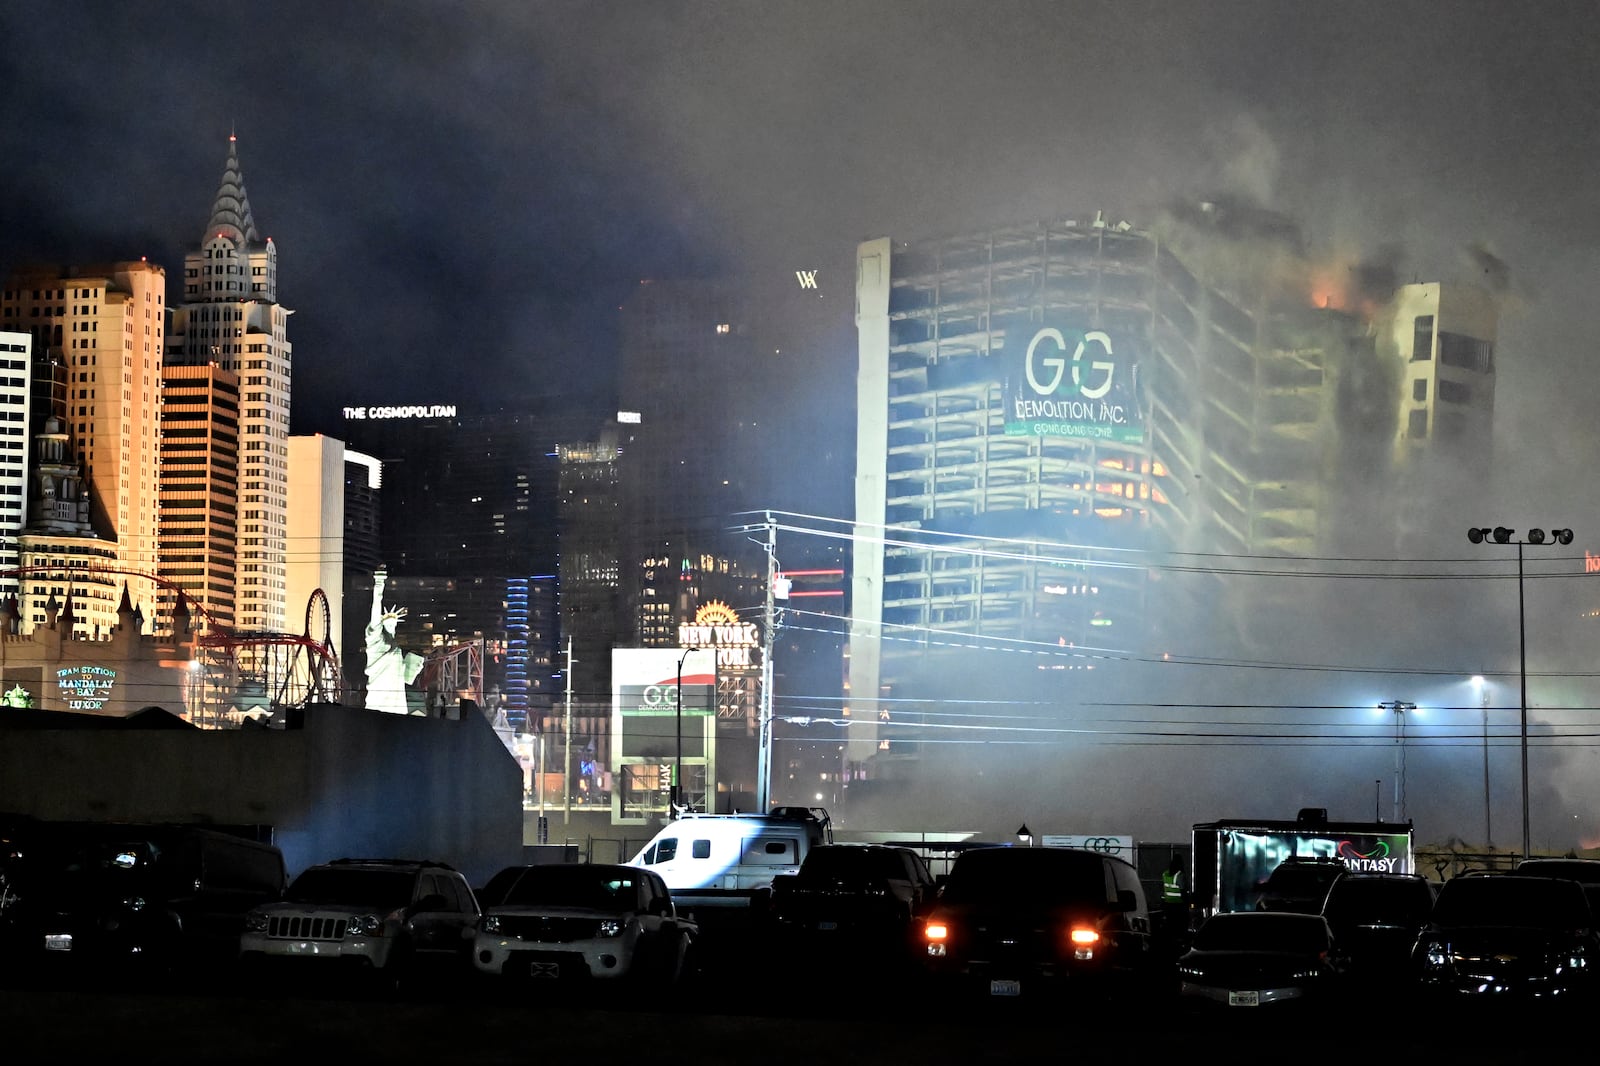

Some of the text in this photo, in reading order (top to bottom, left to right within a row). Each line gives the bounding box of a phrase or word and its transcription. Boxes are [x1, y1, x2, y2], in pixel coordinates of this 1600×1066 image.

[343, 405, 456, 419] THE COSMOPOLITAN
[679, 626, 755, 644] NEW YORK
[57, 666, 116, 678] TRAM STATION
[59, 680, 114, 689] MANDALAY
[77, 688, 95, 697] BAY
[69, 701, 103, 710] LUXOR
